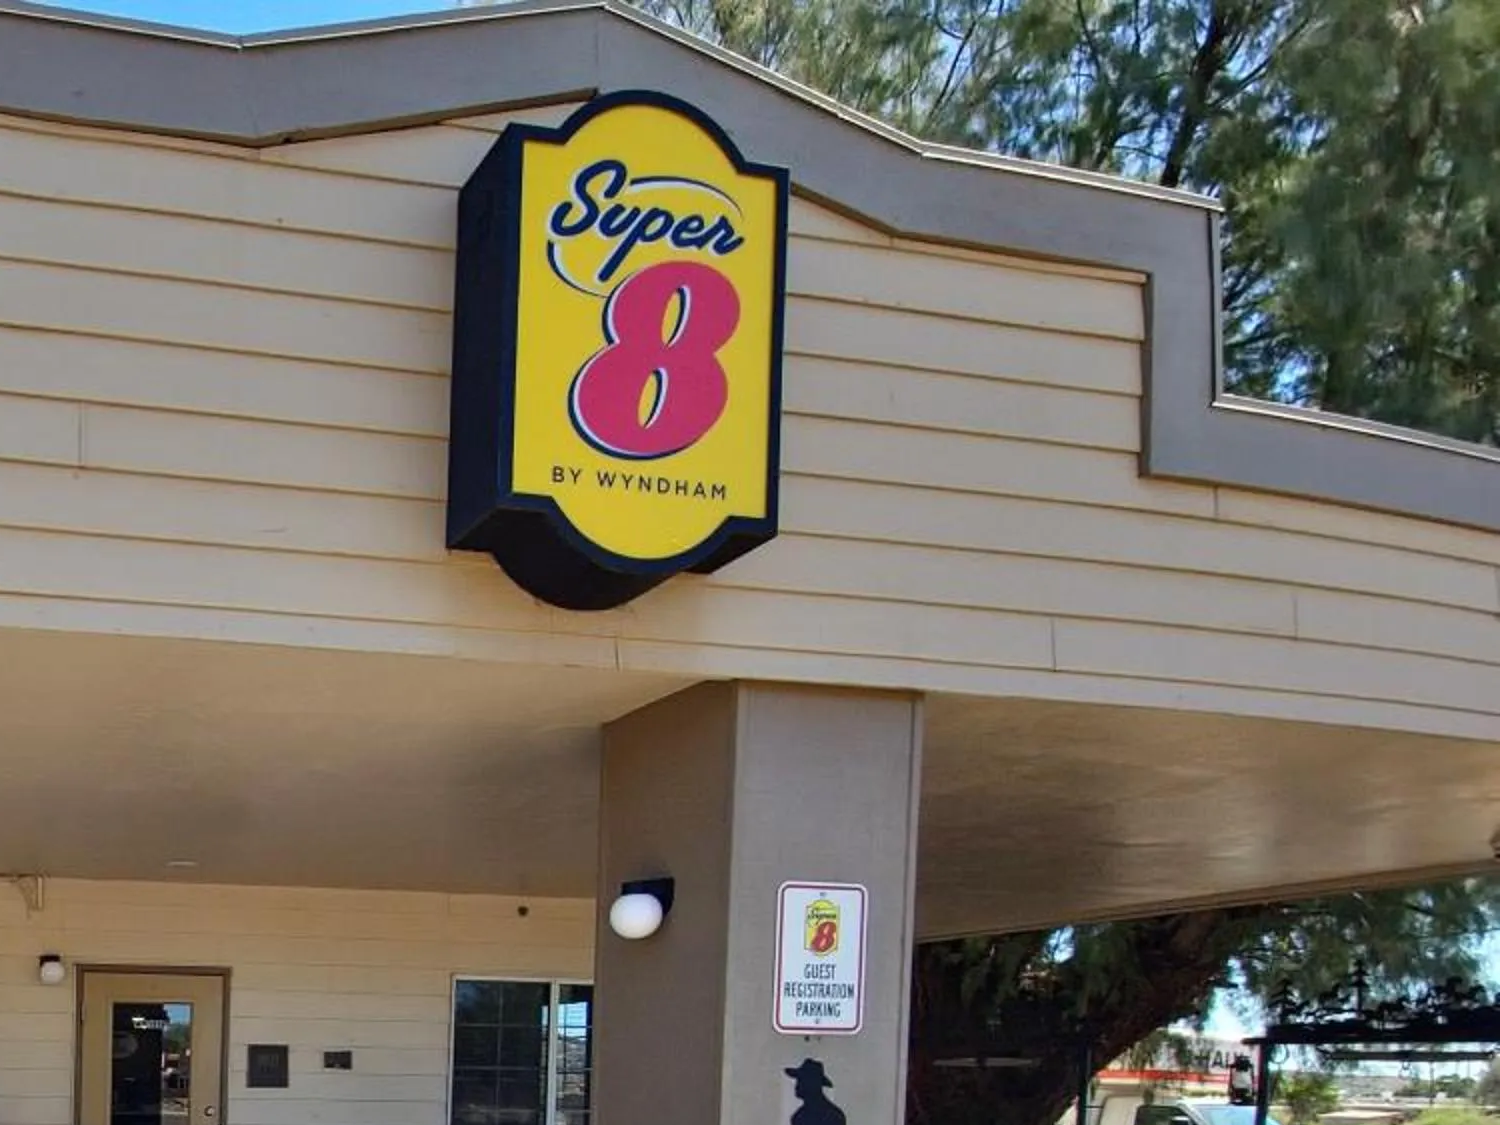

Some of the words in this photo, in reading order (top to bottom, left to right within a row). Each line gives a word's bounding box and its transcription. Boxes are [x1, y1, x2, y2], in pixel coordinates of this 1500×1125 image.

[550, 159, 745, 282] Super
[568, 260, 741, 460] 8
[551, 465, 582, 484] BY
[597, 471, 727, 500] WYNDHAM
[811, 921, 837, 952] 8
[804, 963, 837, 979] GUEST
[784, 981, 855, 999] REGISTRATION
[796, 1001, 841, 1018] PARKING
